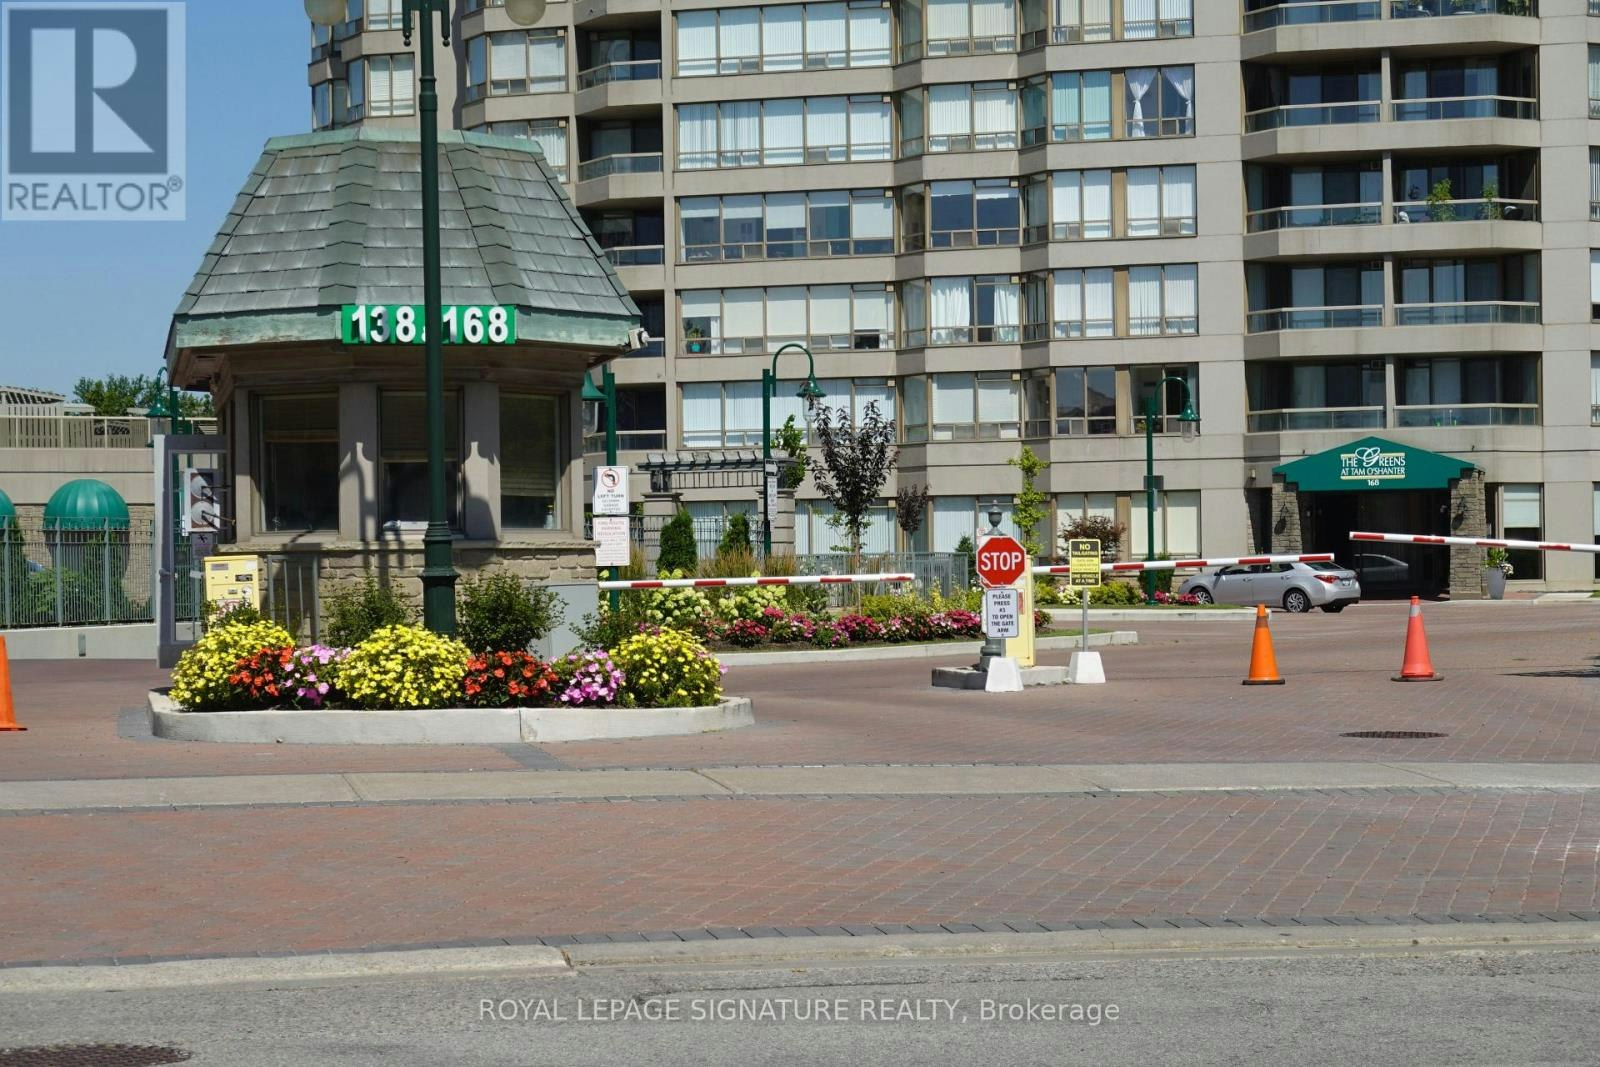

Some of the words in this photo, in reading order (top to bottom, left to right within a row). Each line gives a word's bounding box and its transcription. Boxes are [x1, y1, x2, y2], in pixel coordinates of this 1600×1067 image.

[351, 305, 417, 343] 138
[443, 306, 509, 343] 168
[1342, 457, 1358, 467] THE
[1355, 447, 1406, 467] GREENS
[1366, 467, 1406, 475] O'SHANTER
[1079, 543, 1091, 551] NO
[981, 552, 1022, 571] STOP
